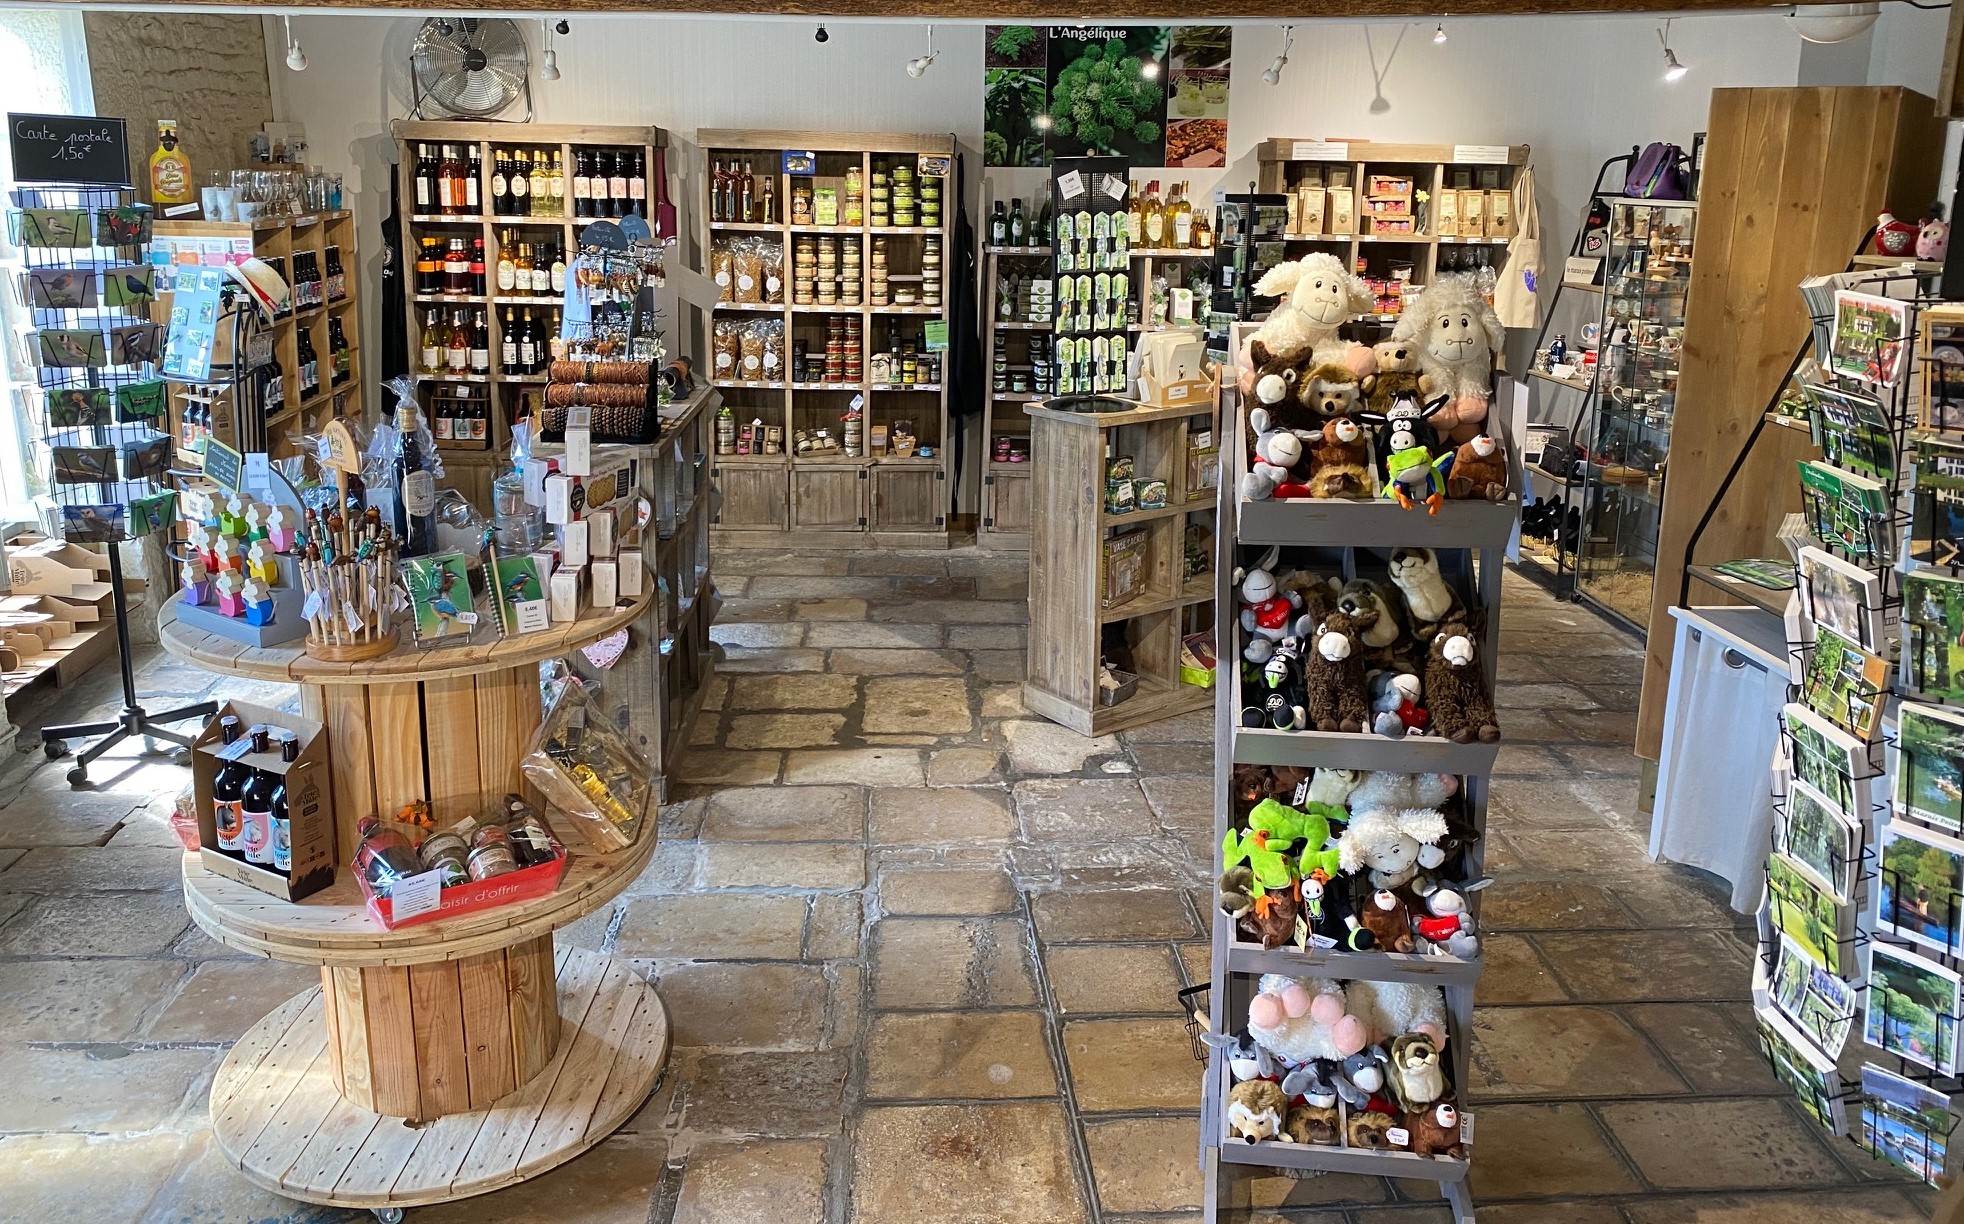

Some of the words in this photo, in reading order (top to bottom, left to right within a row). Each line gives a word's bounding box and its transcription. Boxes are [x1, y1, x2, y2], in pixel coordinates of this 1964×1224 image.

[1049, 27, 1127, 41] L'Angélique
[16, 120, 58, 141] Carte
[64, 128, 113, 146] postale
[440, 896, 470, 910] aisir
[474, 884, 519, 902] d'offrir
